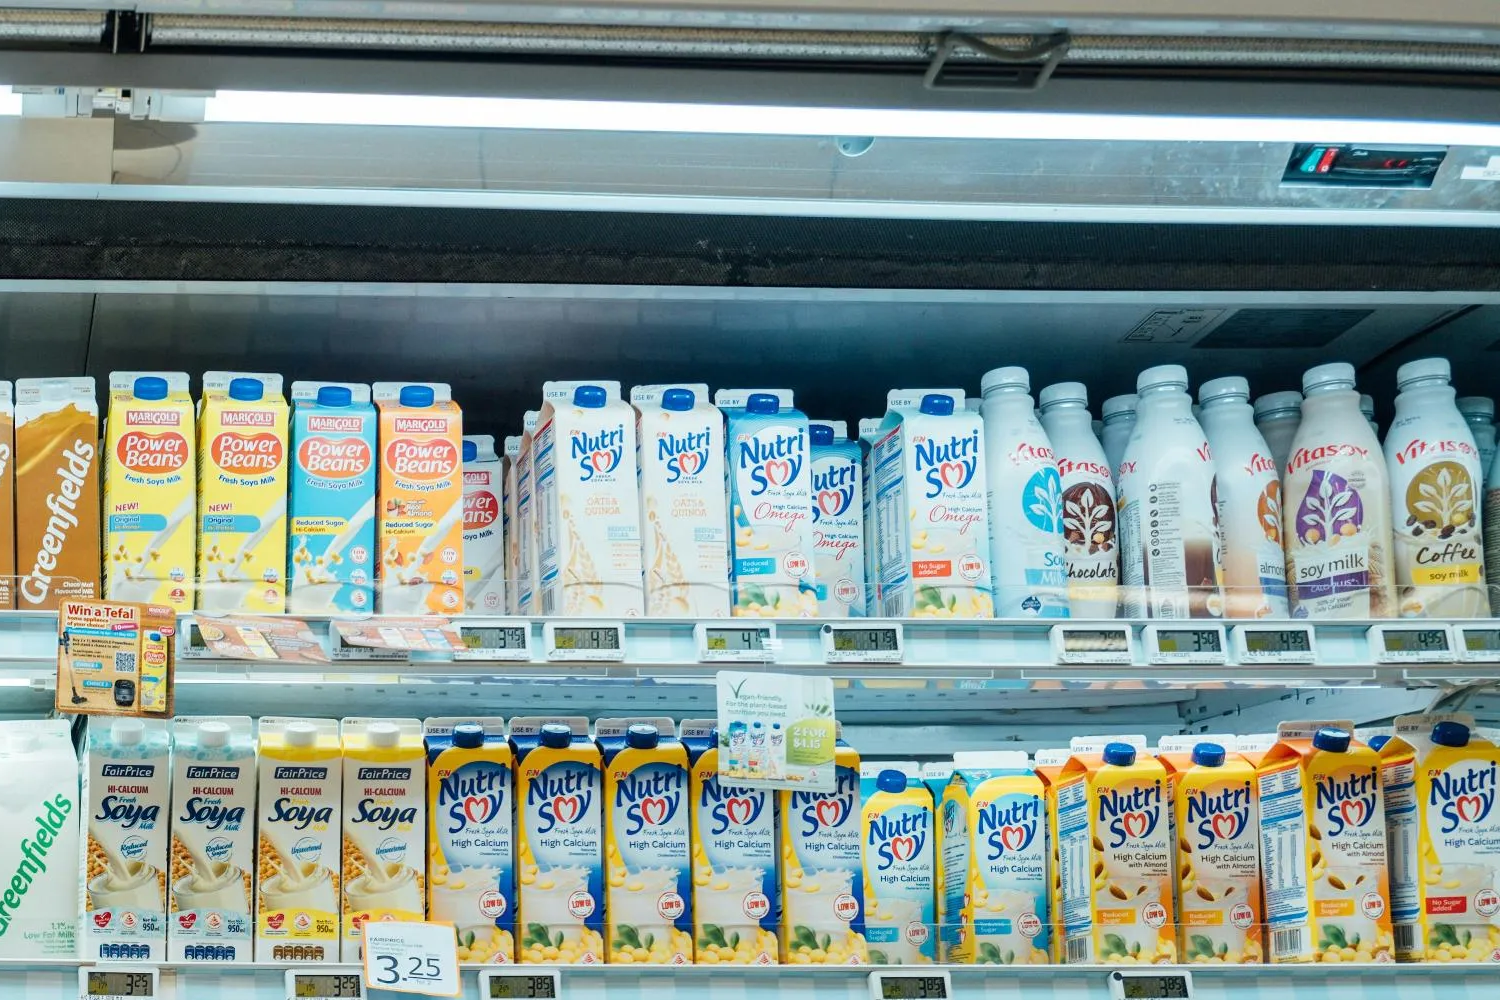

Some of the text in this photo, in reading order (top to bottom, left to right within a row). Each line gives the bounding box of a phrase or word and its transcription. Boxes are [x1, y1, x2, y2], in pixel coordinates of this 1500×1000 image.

[128, 412, 178, 425] MARIGOLD
[124, 436, 183, 453] Power
[572, 424, 624, 458] Nutri
[125, 450, 183, 469] Beans
[125, 474, 182, 486] Fresh Soya Milk
[115, 503, 139, 512] NEW!
[114, 516, 140, 524] Original
[754, 502, 809, 532] Omega
[1416, 542, 1477, 565] Coffee
[1300, 553, 1364, 578] soy milk
[68, 605, 134, 620] Win a Tefal
[103, 764, 154, 777] FairPrice
[108, 786, 149, 794] HI-CALCIUM
[528, 767, 595, 806] Nutri
[1099, 780, 1161, 821] Nutri
[96, 797, 160, 828] Soya
[540, 839, 597, 849] High Calcium
[1113, 852, 1167, 863] High Calcium
